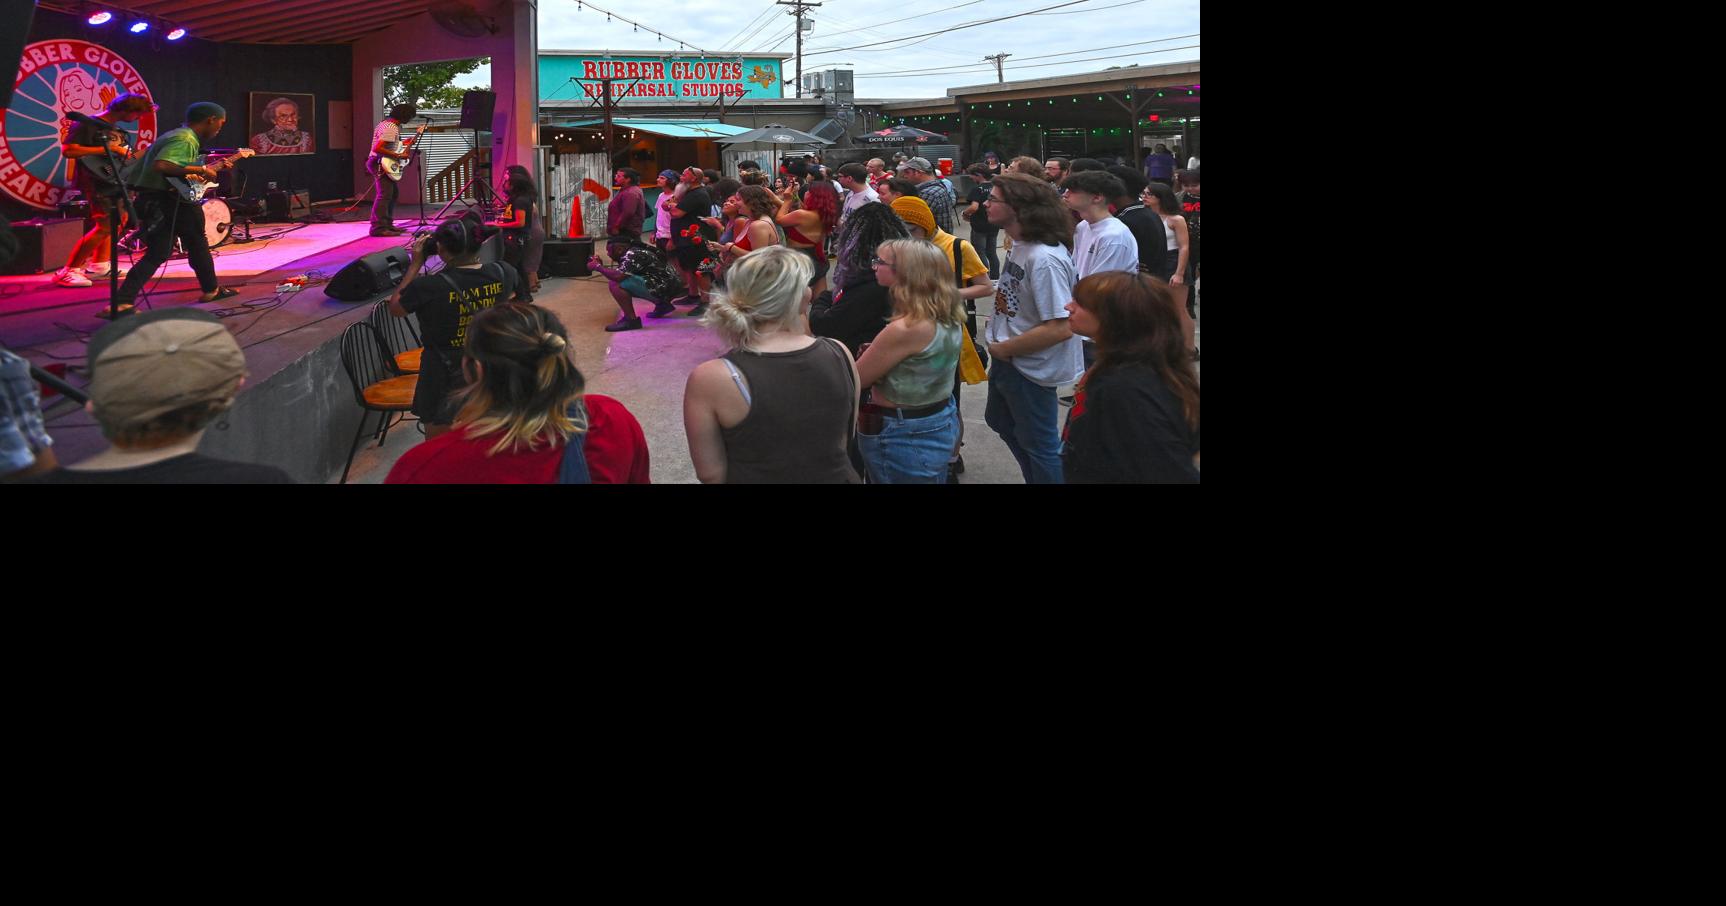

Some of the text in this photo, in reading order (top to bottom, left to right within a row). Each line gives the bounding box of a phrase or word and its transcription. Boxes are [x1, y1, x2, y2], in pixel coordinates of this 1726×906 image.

[16, 43, 149, 99] BBER GLOVE
[582, 60, 743, 80] RUBBER GLOVES
[682, 83, 744, 98] STUDIOS
[482, 282, 503, 295] THE
